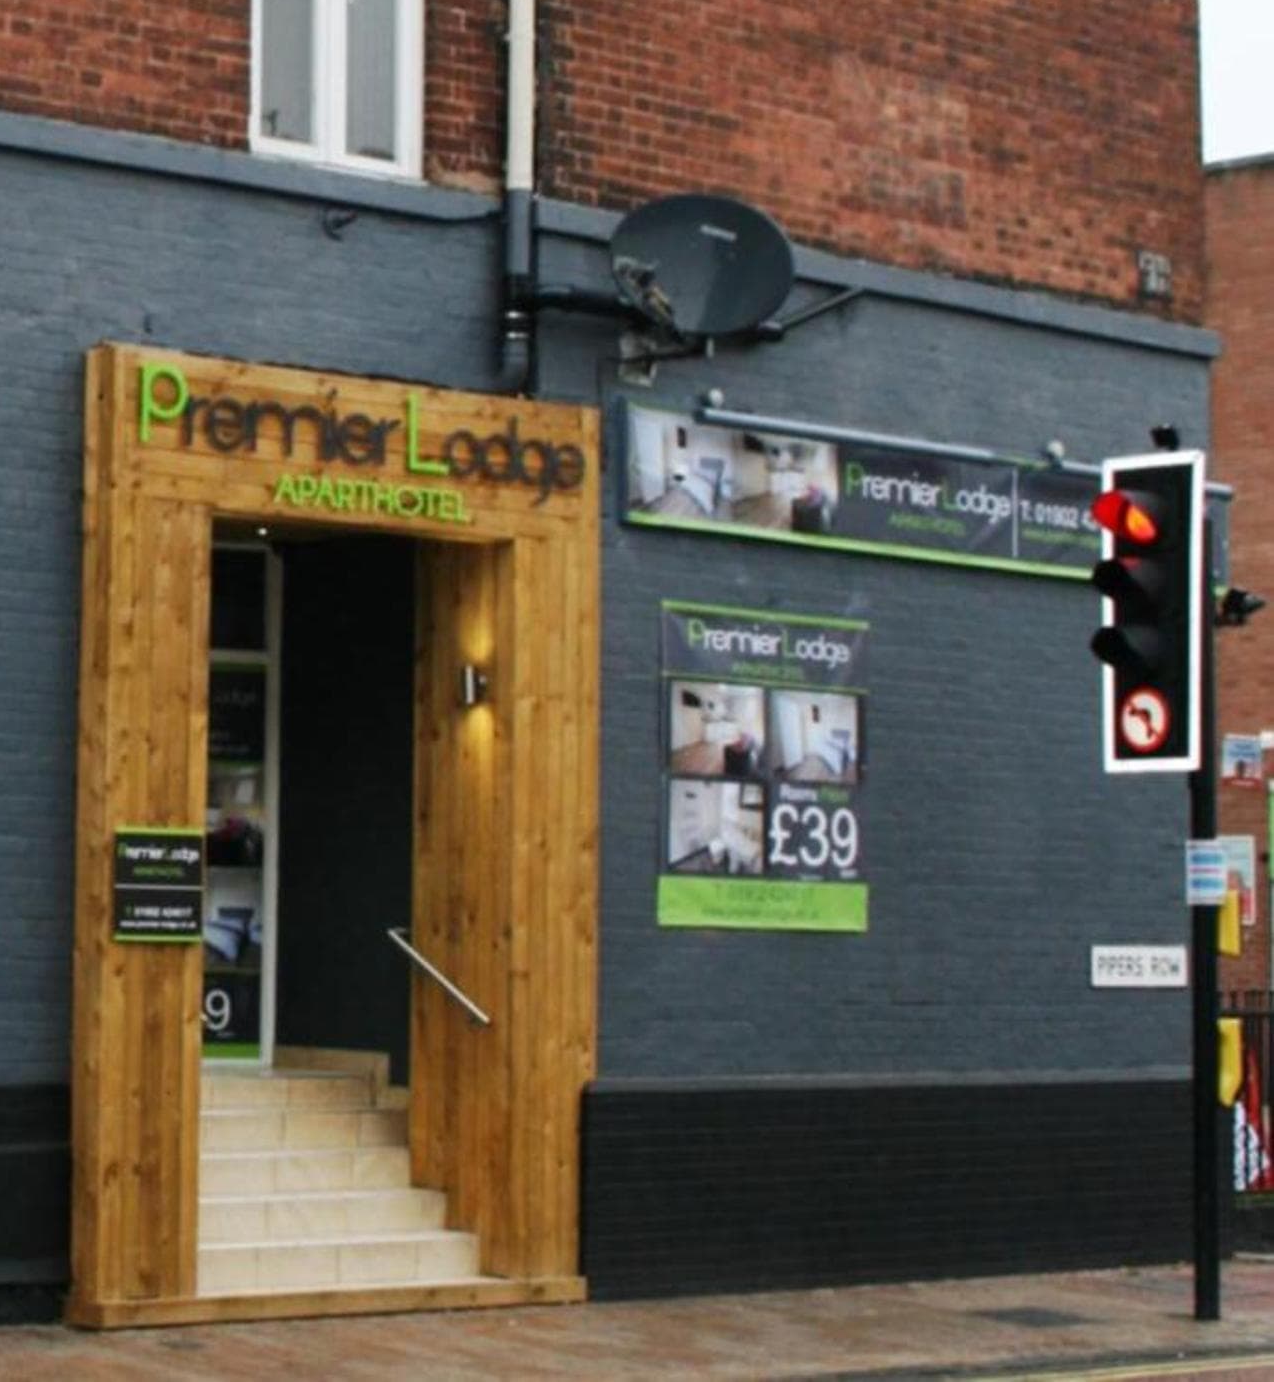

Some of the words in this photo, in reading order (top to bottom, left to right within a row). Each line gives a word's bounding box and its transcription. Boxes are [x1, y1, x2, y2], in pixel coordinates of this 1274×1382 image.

[139, 361, 401, 467] Premier
[406, 391, 586, 507] Lodge
[273, 473, 470, 522] APARTHOTEL
[845, 460, 941, 507] Premier
[941, 474, 1011, 525] Lodge
[687, 618, 782, 656] Premier
[782, 628, 851, 669] Lodge
[768, 803, 858, 868] £39
